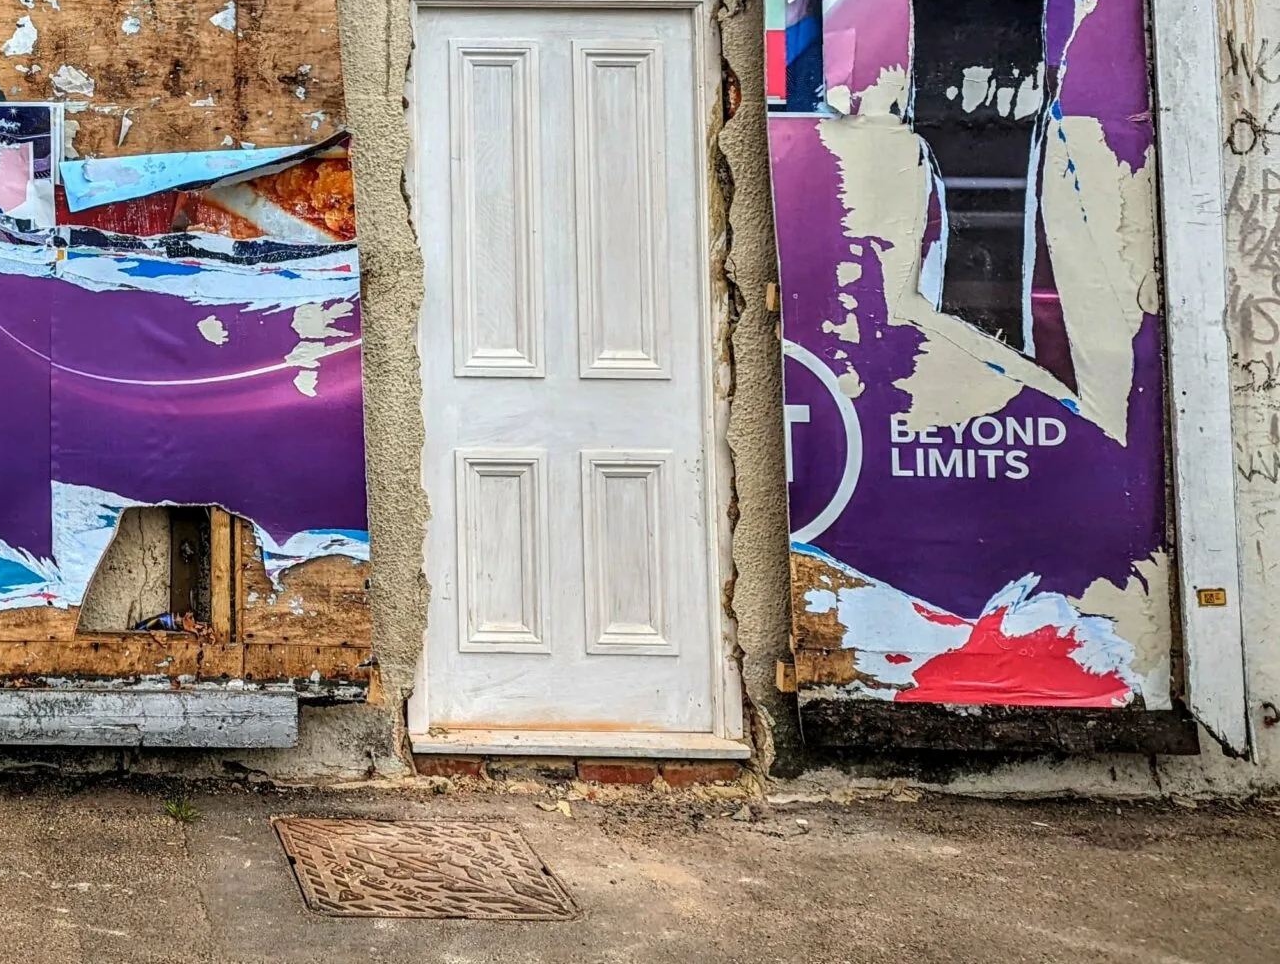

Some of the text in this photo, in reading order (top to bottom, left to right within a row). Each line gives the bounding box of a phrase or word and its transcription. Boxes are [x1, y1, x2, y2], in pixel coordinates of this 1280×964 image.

[890, 415, 1067, 447] BEYOND
[891, 447, 1030, 480] LIMITS
[323, 860, 442, 903] Thames Water
